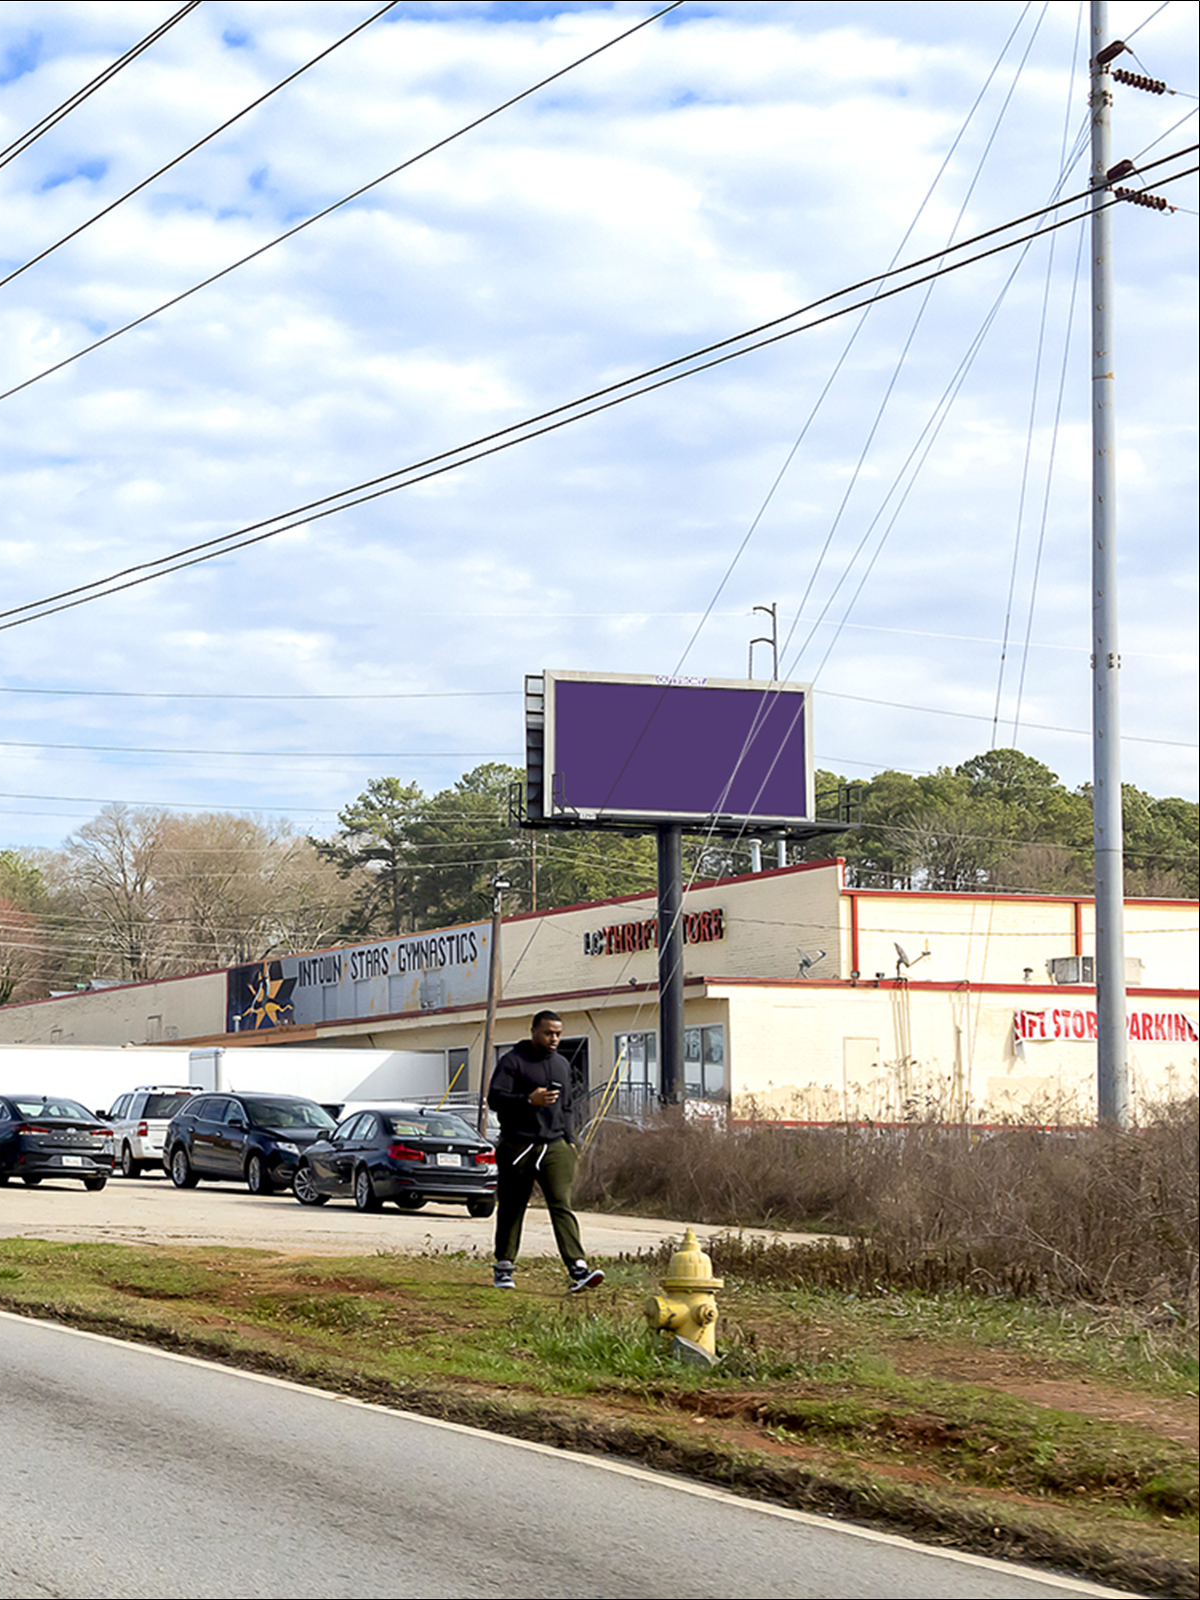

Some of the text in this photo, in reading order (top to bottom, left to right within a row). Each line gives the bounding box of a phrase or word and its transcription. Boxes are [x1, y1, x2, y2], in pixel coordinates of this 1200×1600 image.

[584, 929, 603, 955] LC
[298, 931, 478, 988] INTOWN STARS GYMNASTICS
[1052, 1008, 1098, 1039] STOR
